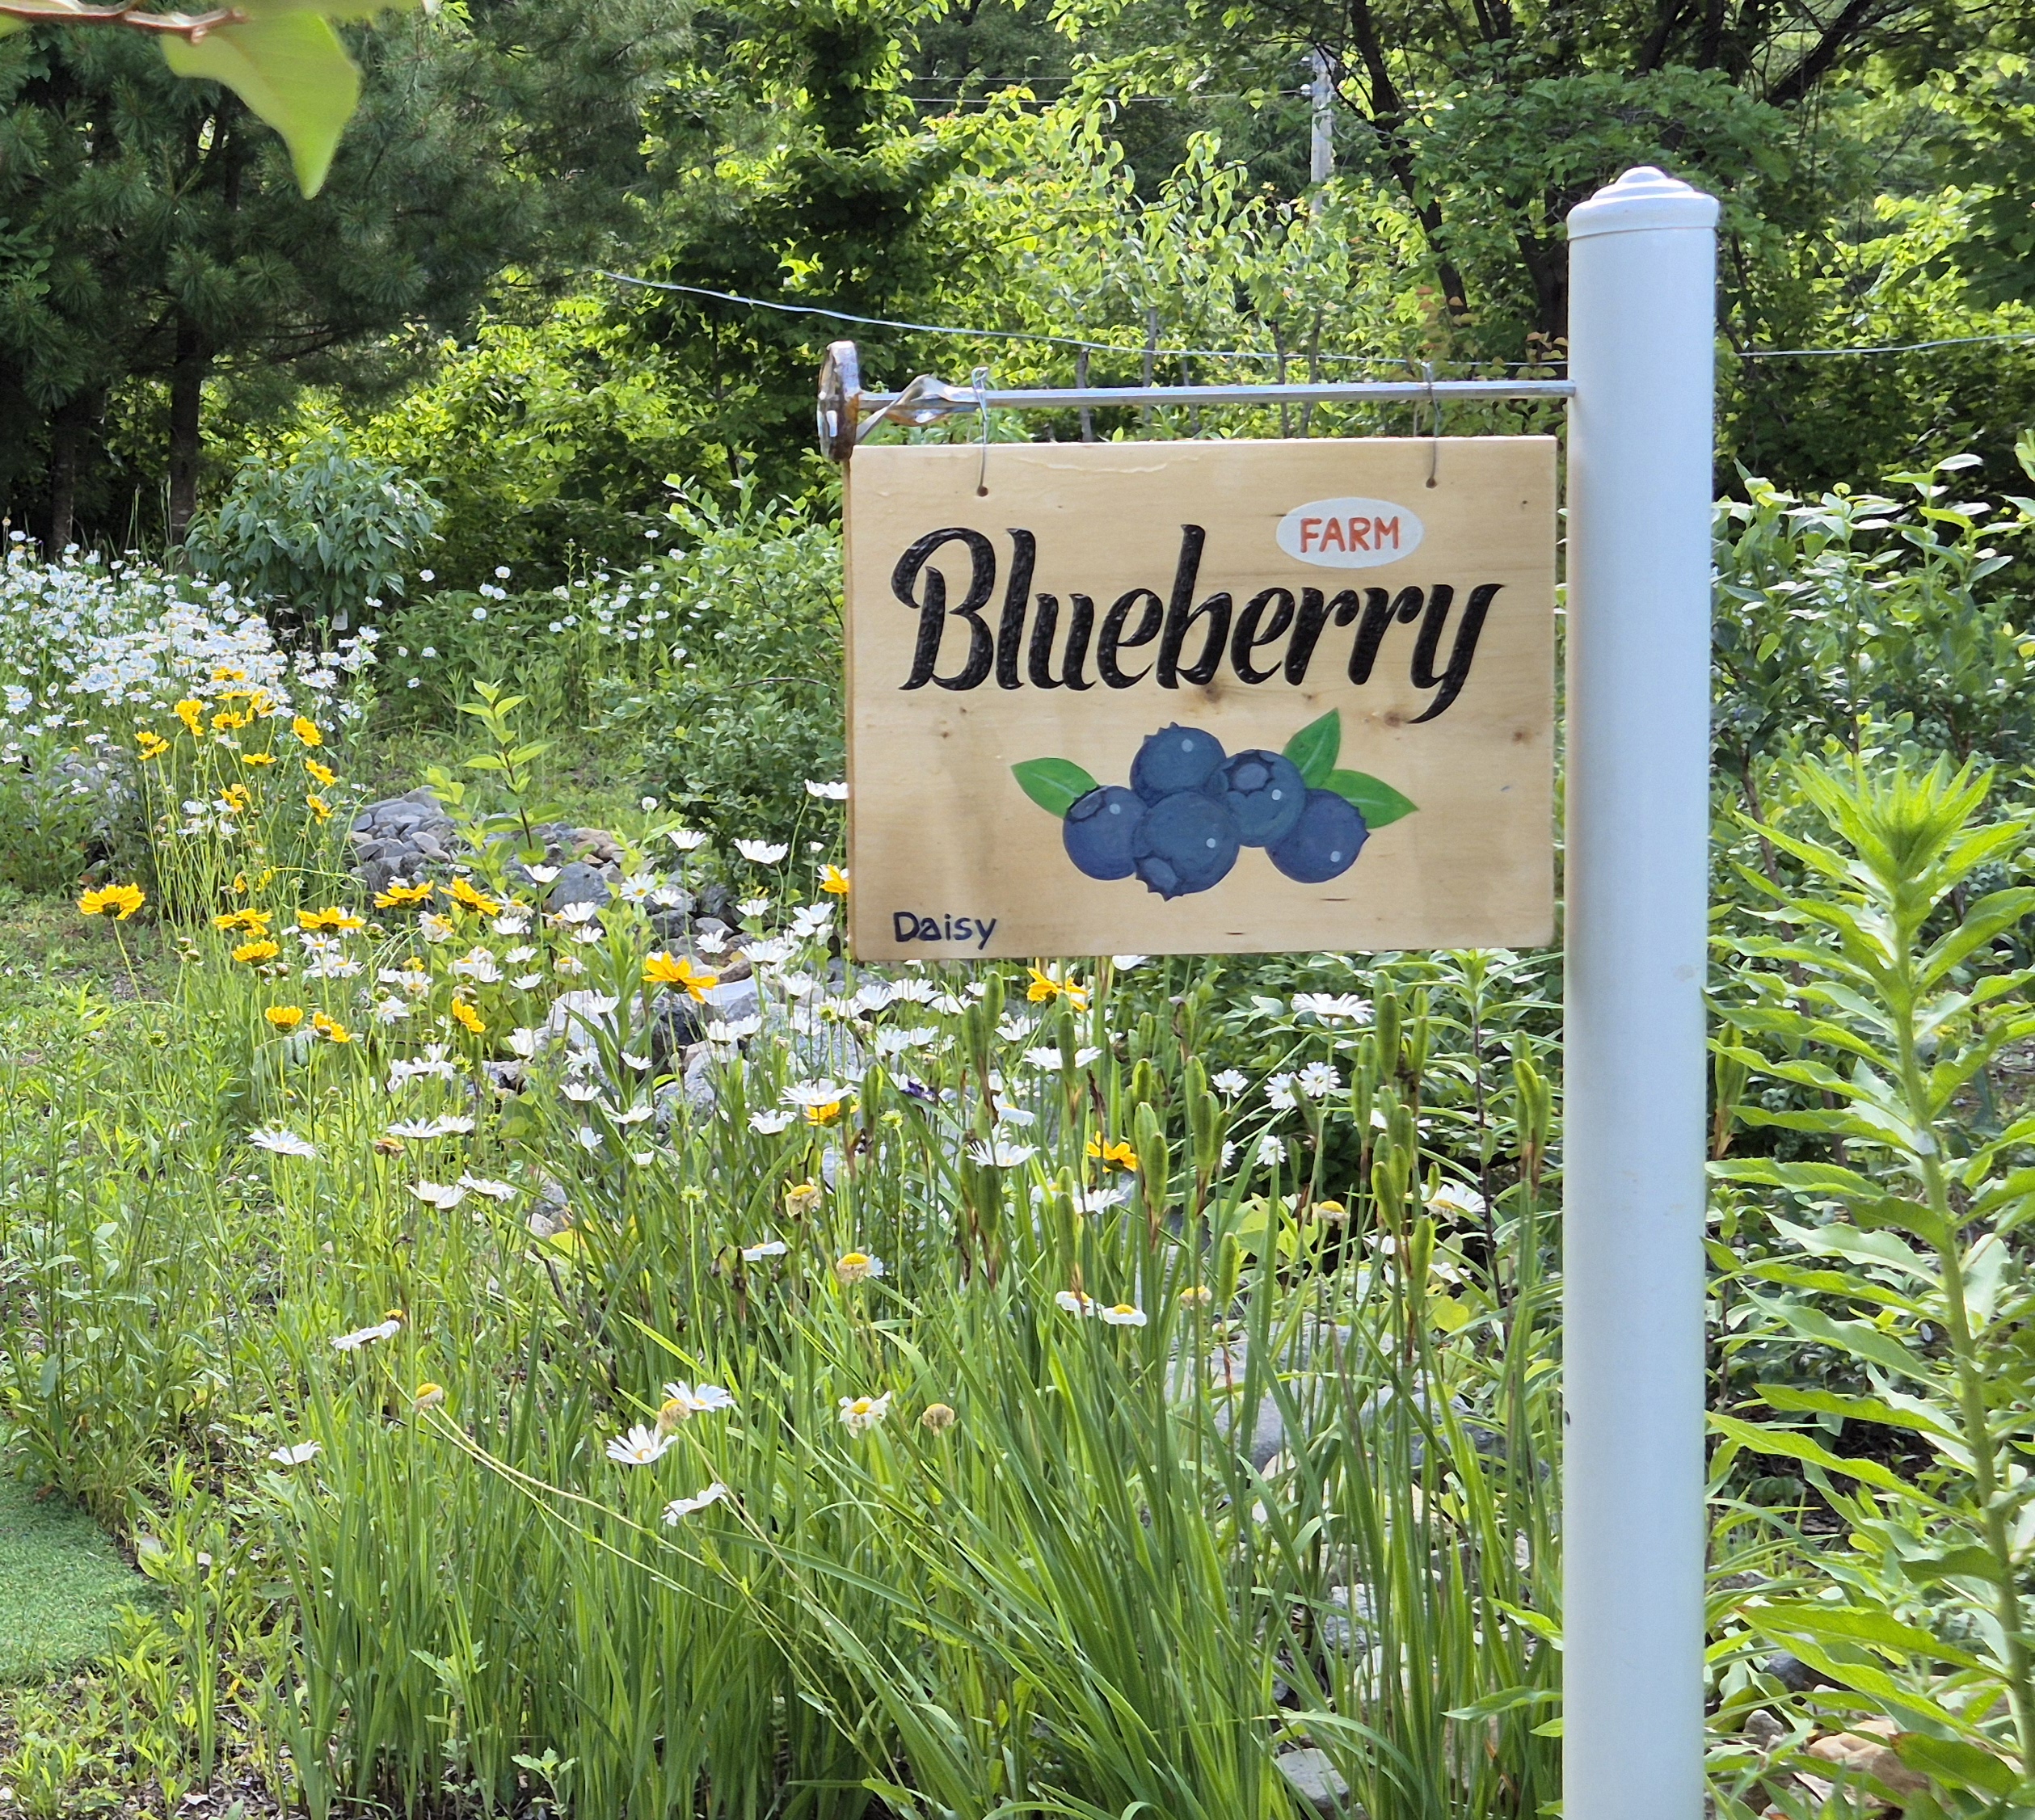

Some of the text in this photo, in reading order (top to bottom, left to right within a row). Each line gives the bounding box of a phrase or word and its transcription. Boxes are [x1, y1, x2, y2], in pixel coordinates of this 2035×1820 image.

[1299, 516, 1401, 554] FARM
[891, 524, 1505, 724] Blueberry
[893, 911, 997, 950] Daisy
